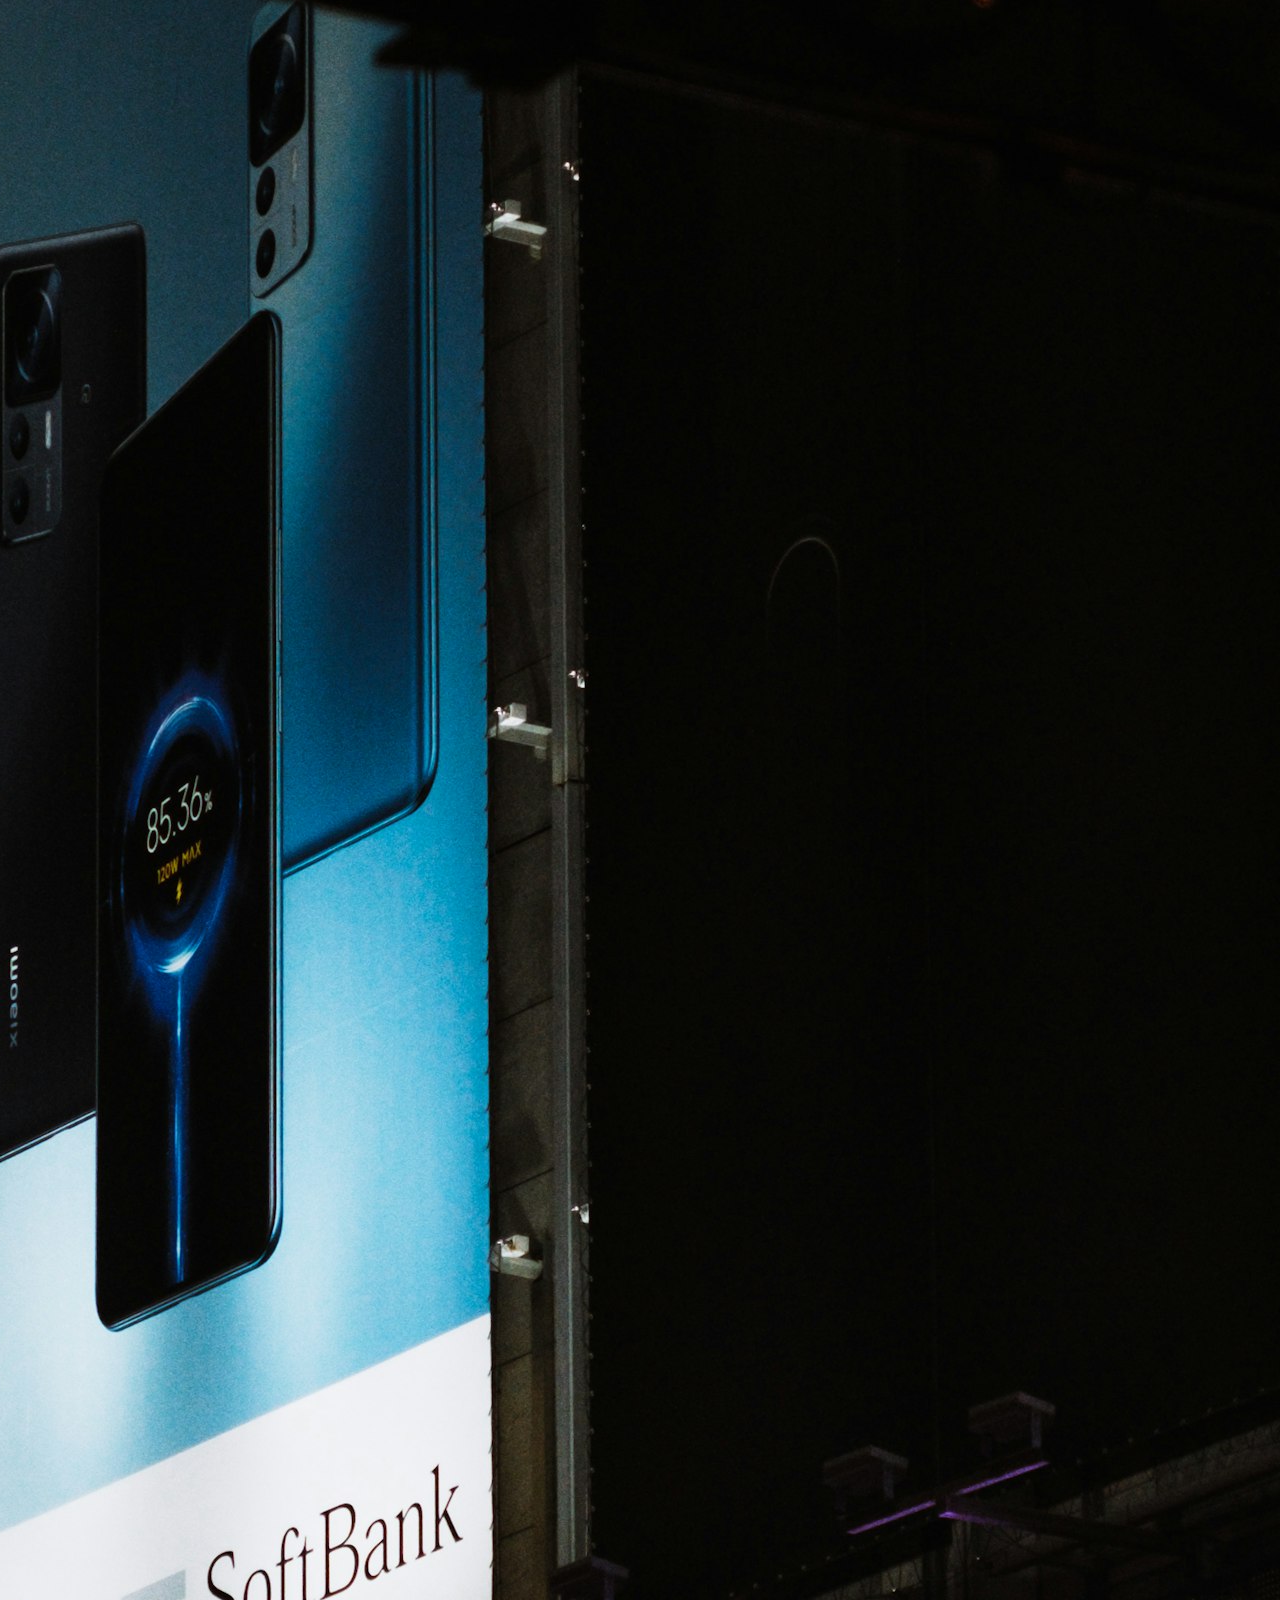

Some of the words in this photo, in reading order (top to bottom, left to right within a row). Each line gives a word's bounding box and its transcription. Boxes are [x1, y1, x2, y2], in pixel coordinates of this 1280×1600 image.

[147, 774, 213, 854] 85.36%
[157, 856, 179, 885] 120W
[181, 840, 202, 867] MAX
